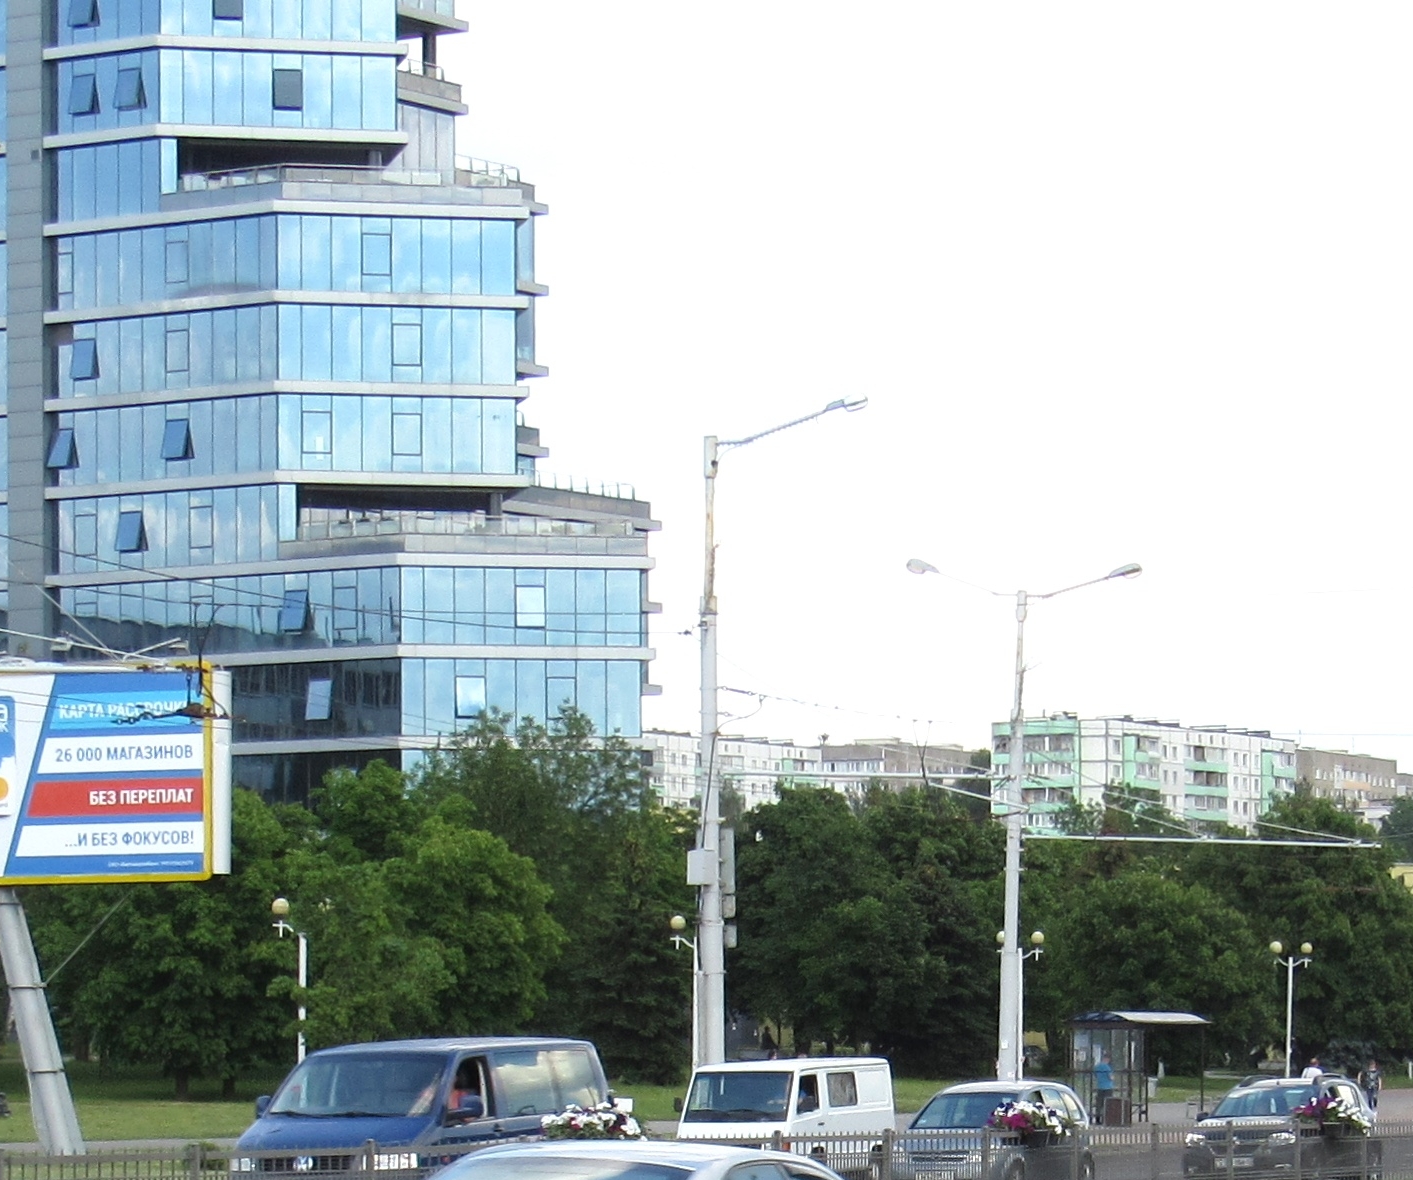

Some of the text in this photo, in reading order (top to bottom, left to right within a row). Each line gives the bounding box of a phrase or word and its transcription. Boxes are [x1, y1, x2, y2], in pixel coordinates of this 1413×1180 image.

[59, 703, 104, 719] КАРТА
[56, 745, 193, 763] 26 000 МАГАЗИНОВ
[89, 788, 194, 806] БЕЗ ПЕРЕПЛАТ
[91, 832, 118, 847] БЕЗ
[122, 830, 194, 847] ФОКУСОВ!
